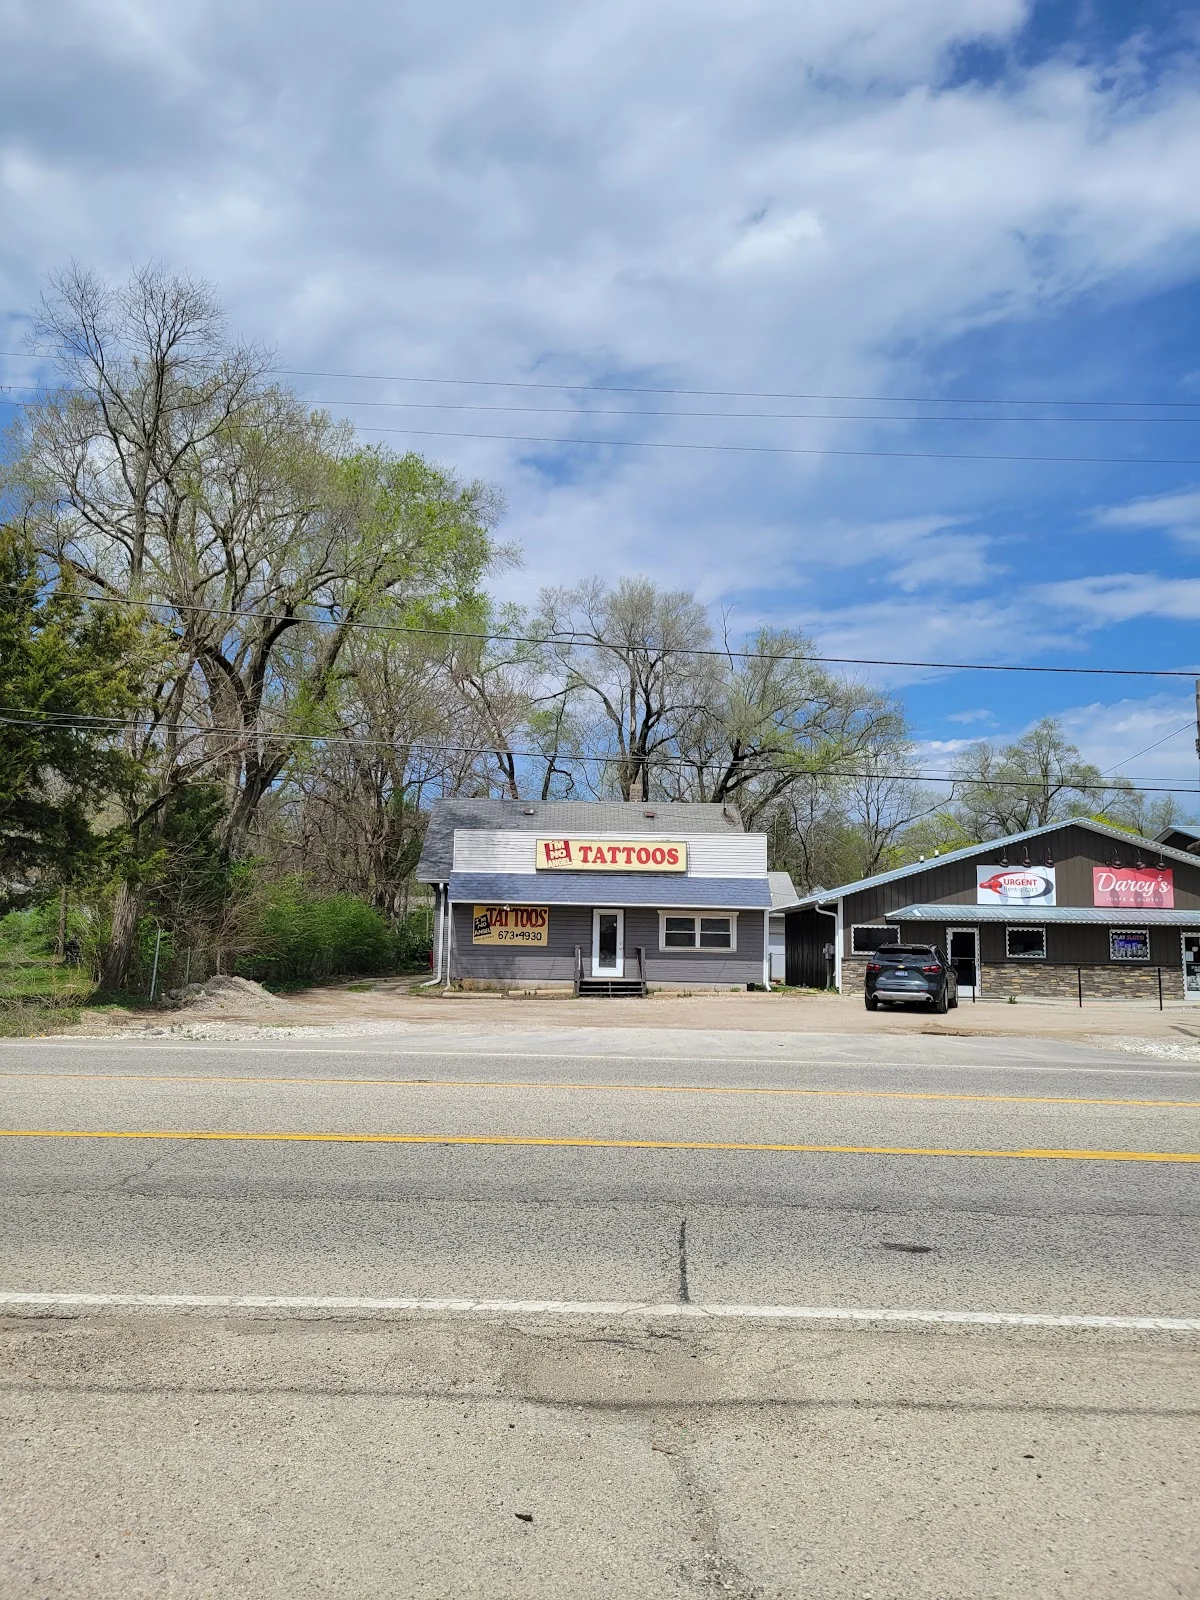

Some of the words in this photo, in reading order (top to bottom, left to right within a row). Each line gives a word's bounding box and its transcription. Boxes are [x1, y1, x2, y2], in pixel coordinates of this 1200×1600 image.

[550, 848, 567, 859] NO
[578, 845, 680, 865] TATTOOS
[548, 857, 573, 868] ANGEL
[1003, 878, 1037, 886] URGENT
[1096, 872, 1171, 897] Darcy's
[486, 907, 548, 928] TATTOOS
[474, 927, 491, 936] ANGEL
